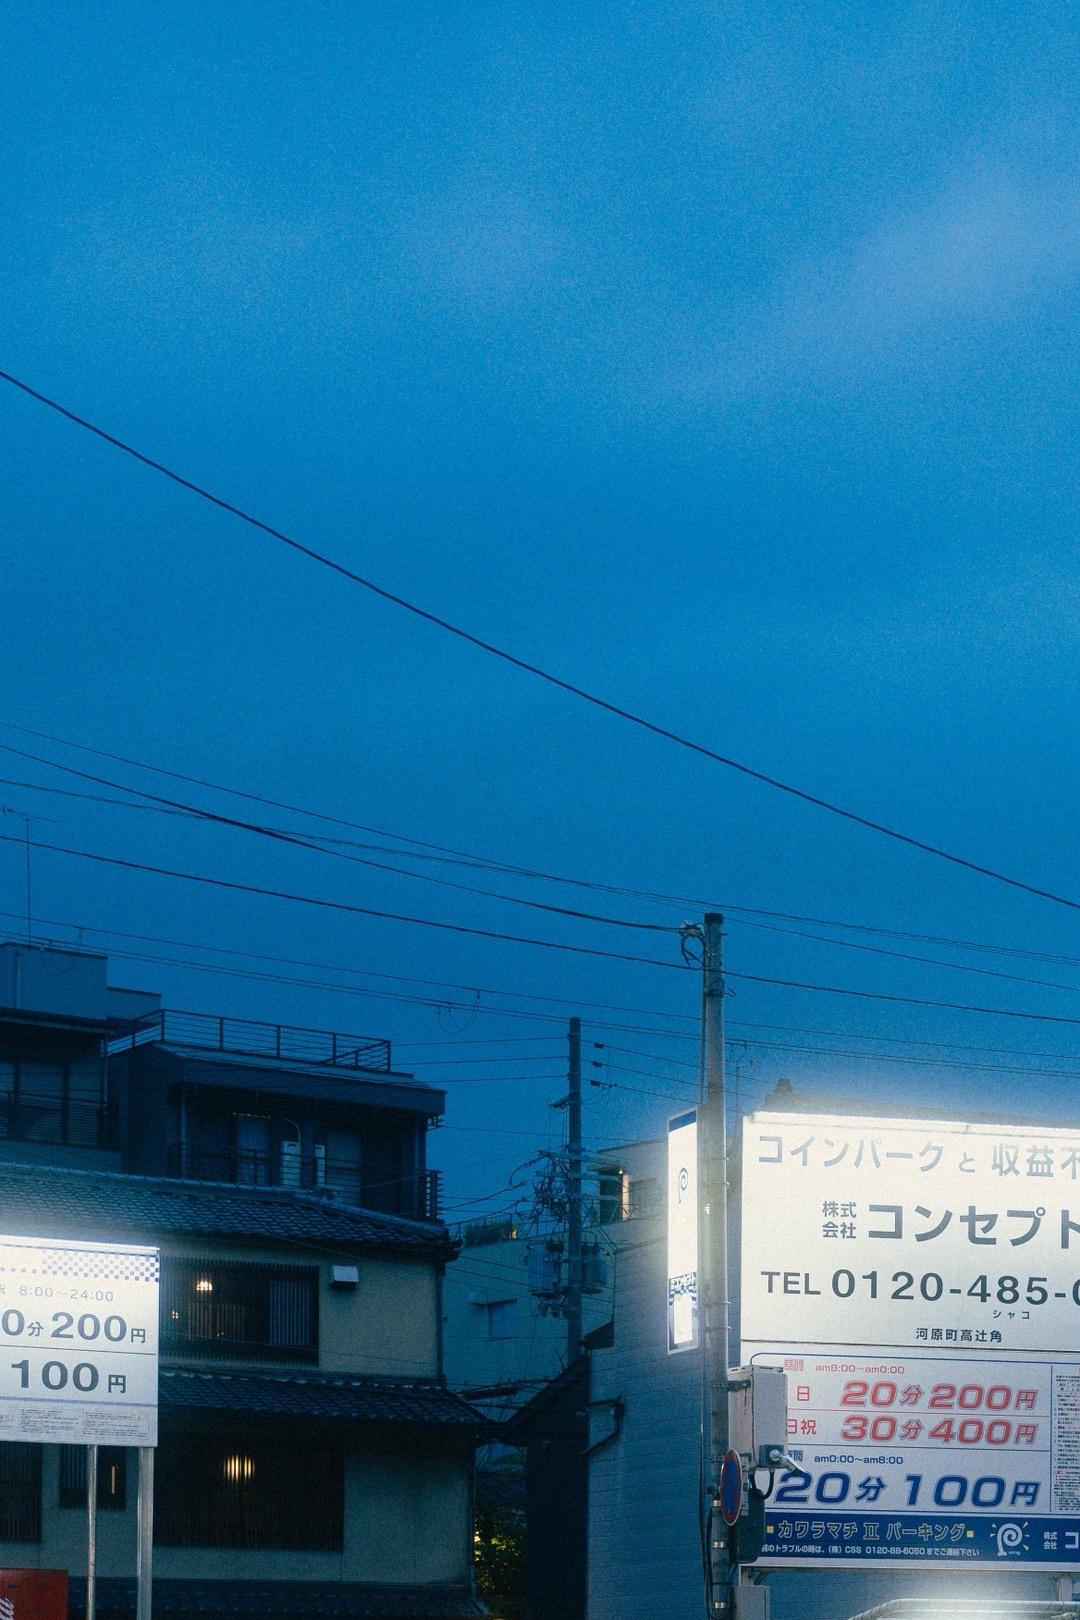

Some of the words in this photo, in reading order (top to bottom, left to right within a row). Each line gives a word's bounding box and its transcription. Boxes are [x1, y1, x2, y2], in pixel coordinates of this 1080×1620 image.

[761, 1271, 821, 1295] TEL
[916, 1327, 1002, 1343] 河原町高辻角
[886, 1521, 966, 1542] パーキング
